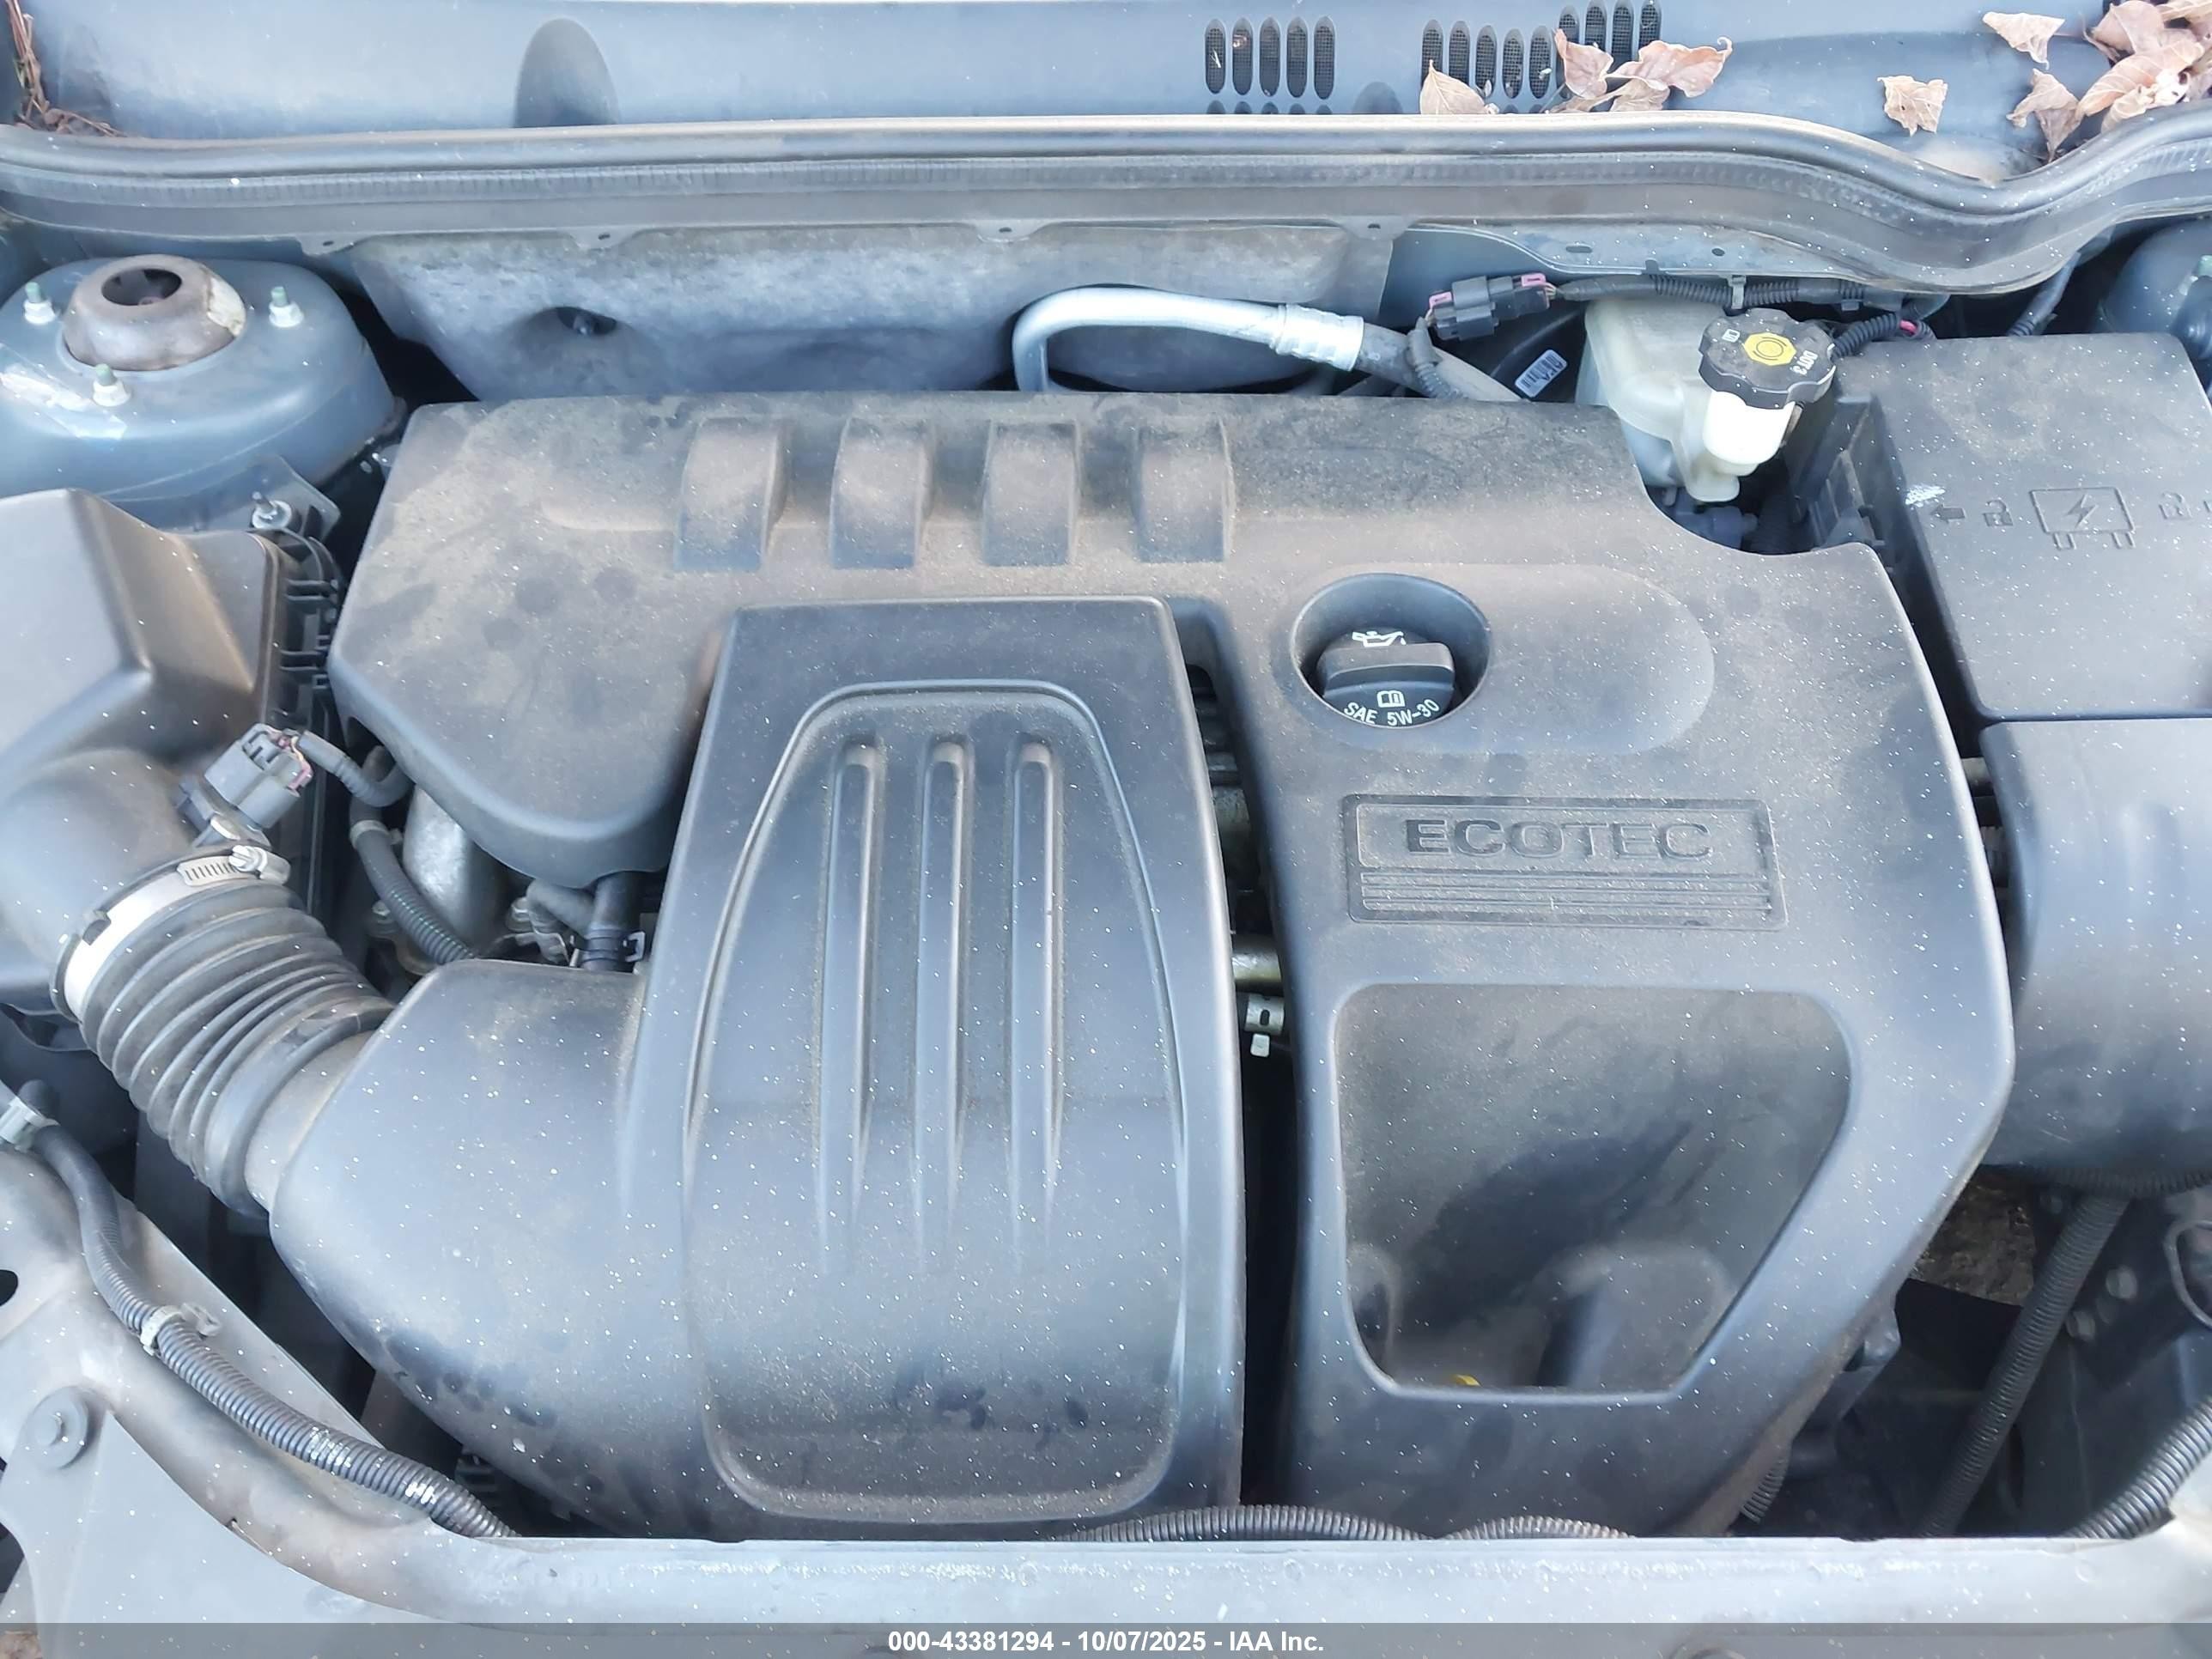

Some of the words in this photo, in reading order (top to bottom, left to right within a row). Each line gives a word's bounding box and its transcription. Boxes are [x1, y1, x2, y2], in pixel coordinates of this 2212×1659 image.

[1792, 365, 1808, 375] 3
[1796, 349, 1819, 370] DOT
[1343, 702, 1379, 725] SAE
[1387, 698, 1440, 726] 5W-30
[1405, 818, 1712, 860] ECOTEC
